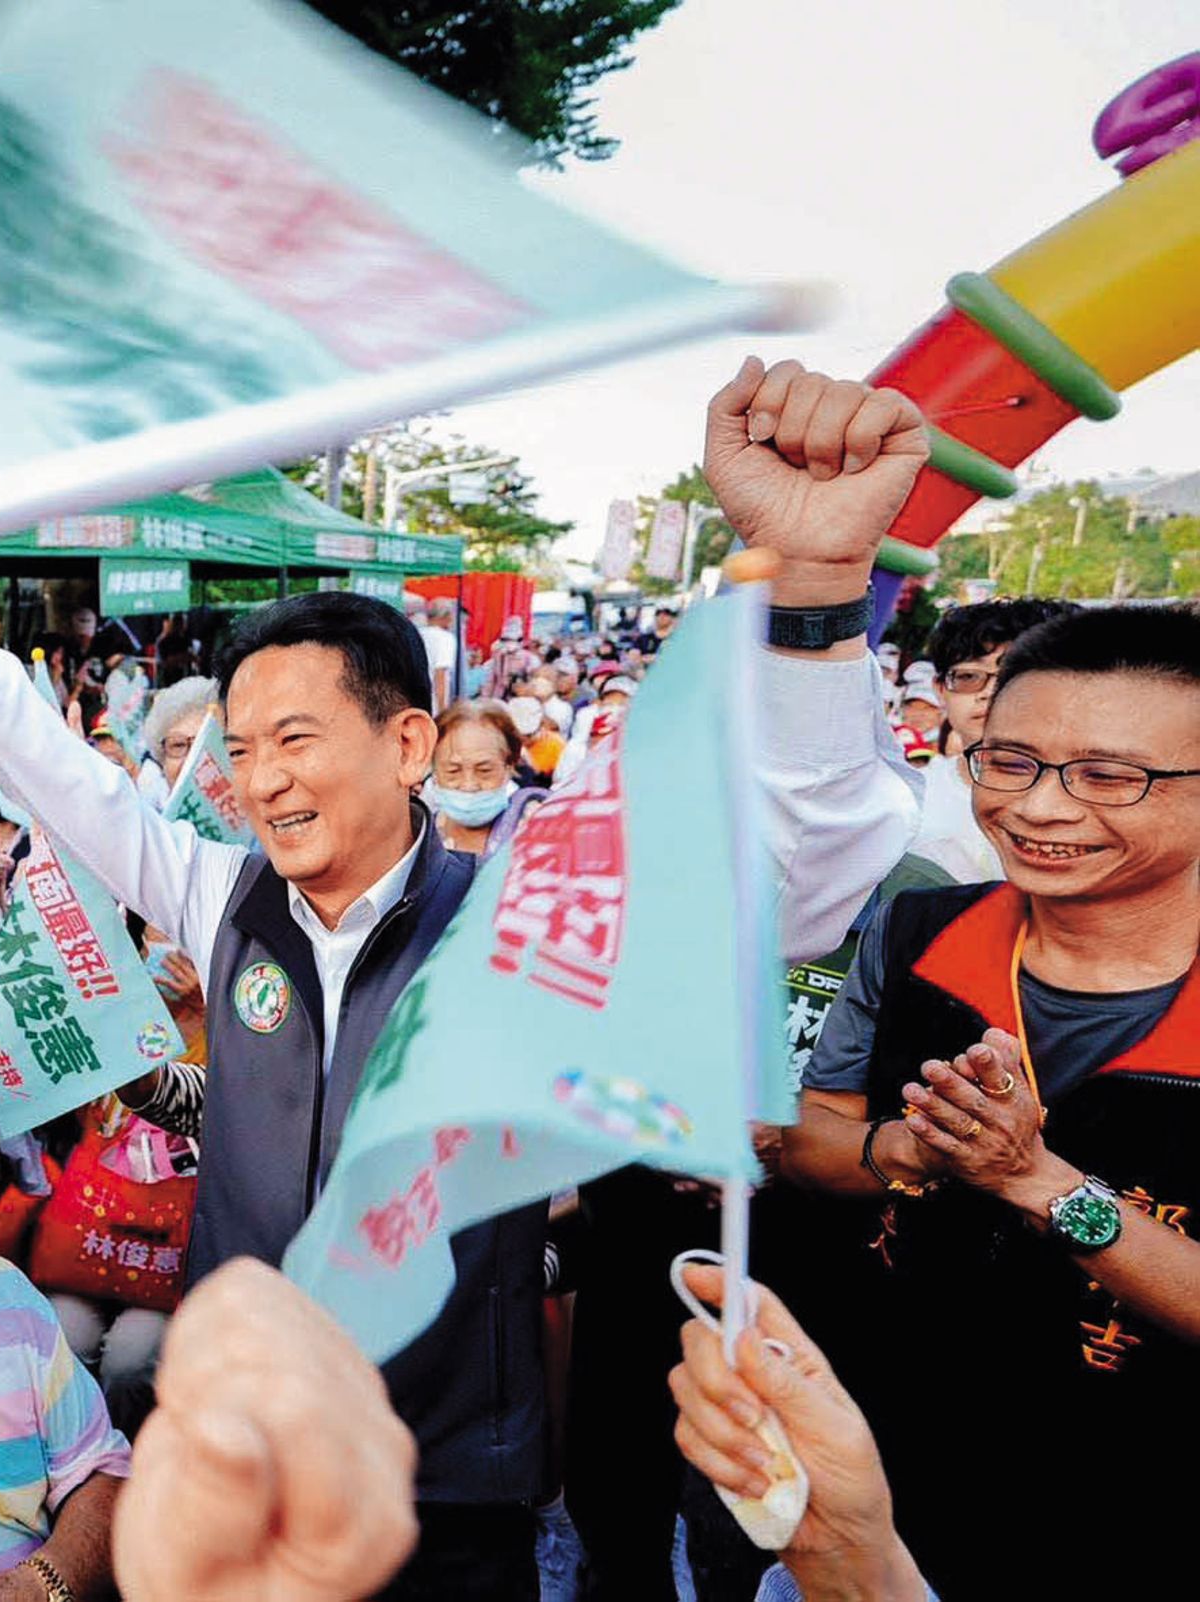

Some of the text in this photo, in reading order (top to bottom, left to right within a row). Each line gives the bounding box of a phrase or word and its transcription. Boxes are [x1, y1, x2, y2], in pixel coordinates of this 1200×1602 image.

[26, 838, 119, 1000] 南最好!!
[82, 1227, 182, 1274] 林俊憲
